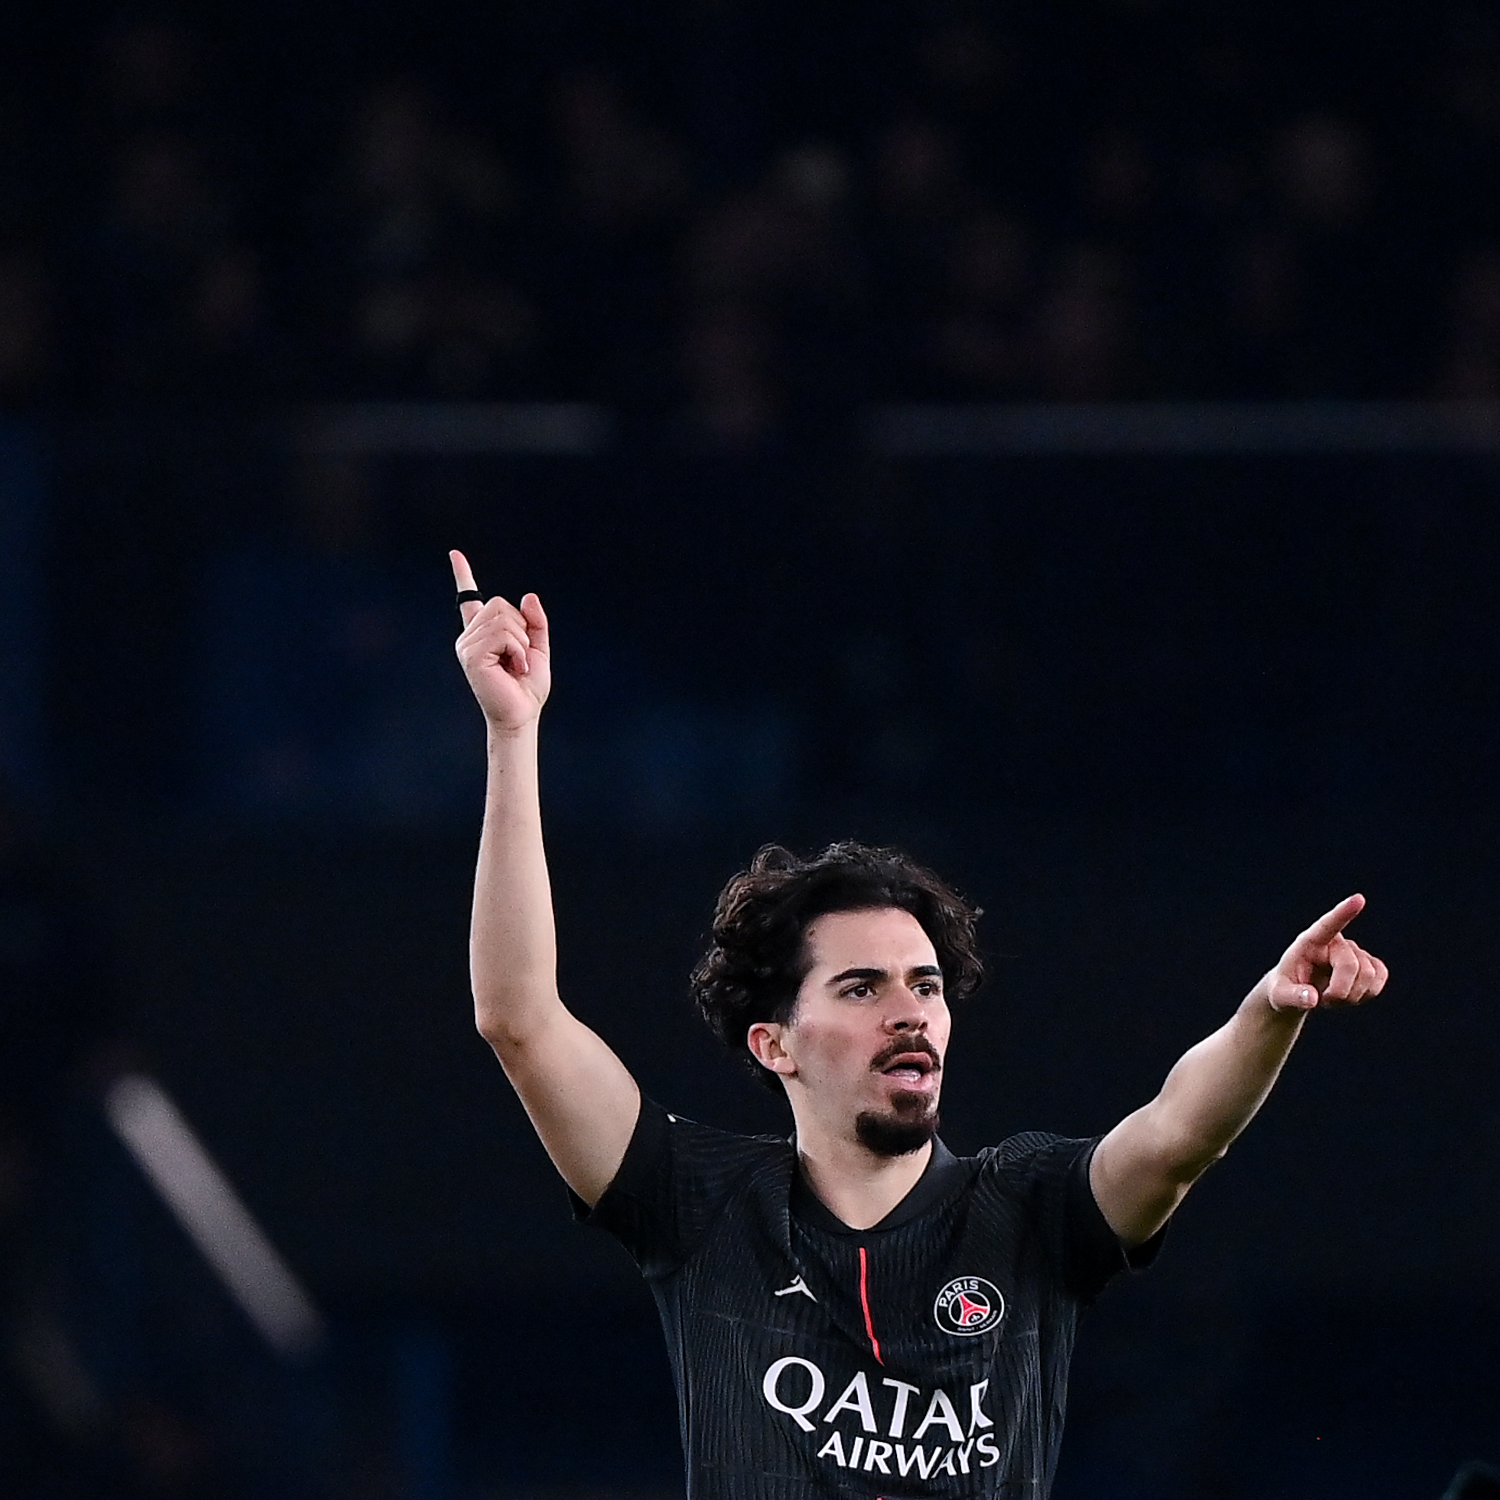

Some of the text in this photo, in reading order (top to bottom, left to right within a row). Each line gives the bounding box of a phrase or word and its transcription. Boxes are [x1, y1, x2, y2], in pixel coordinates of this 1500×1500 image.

[938, 1279, 979, 1308] PARIS
[762, 1356, 994, 1442] QATAR
[817, 1430, 1000, 1480] AIRWAYS
